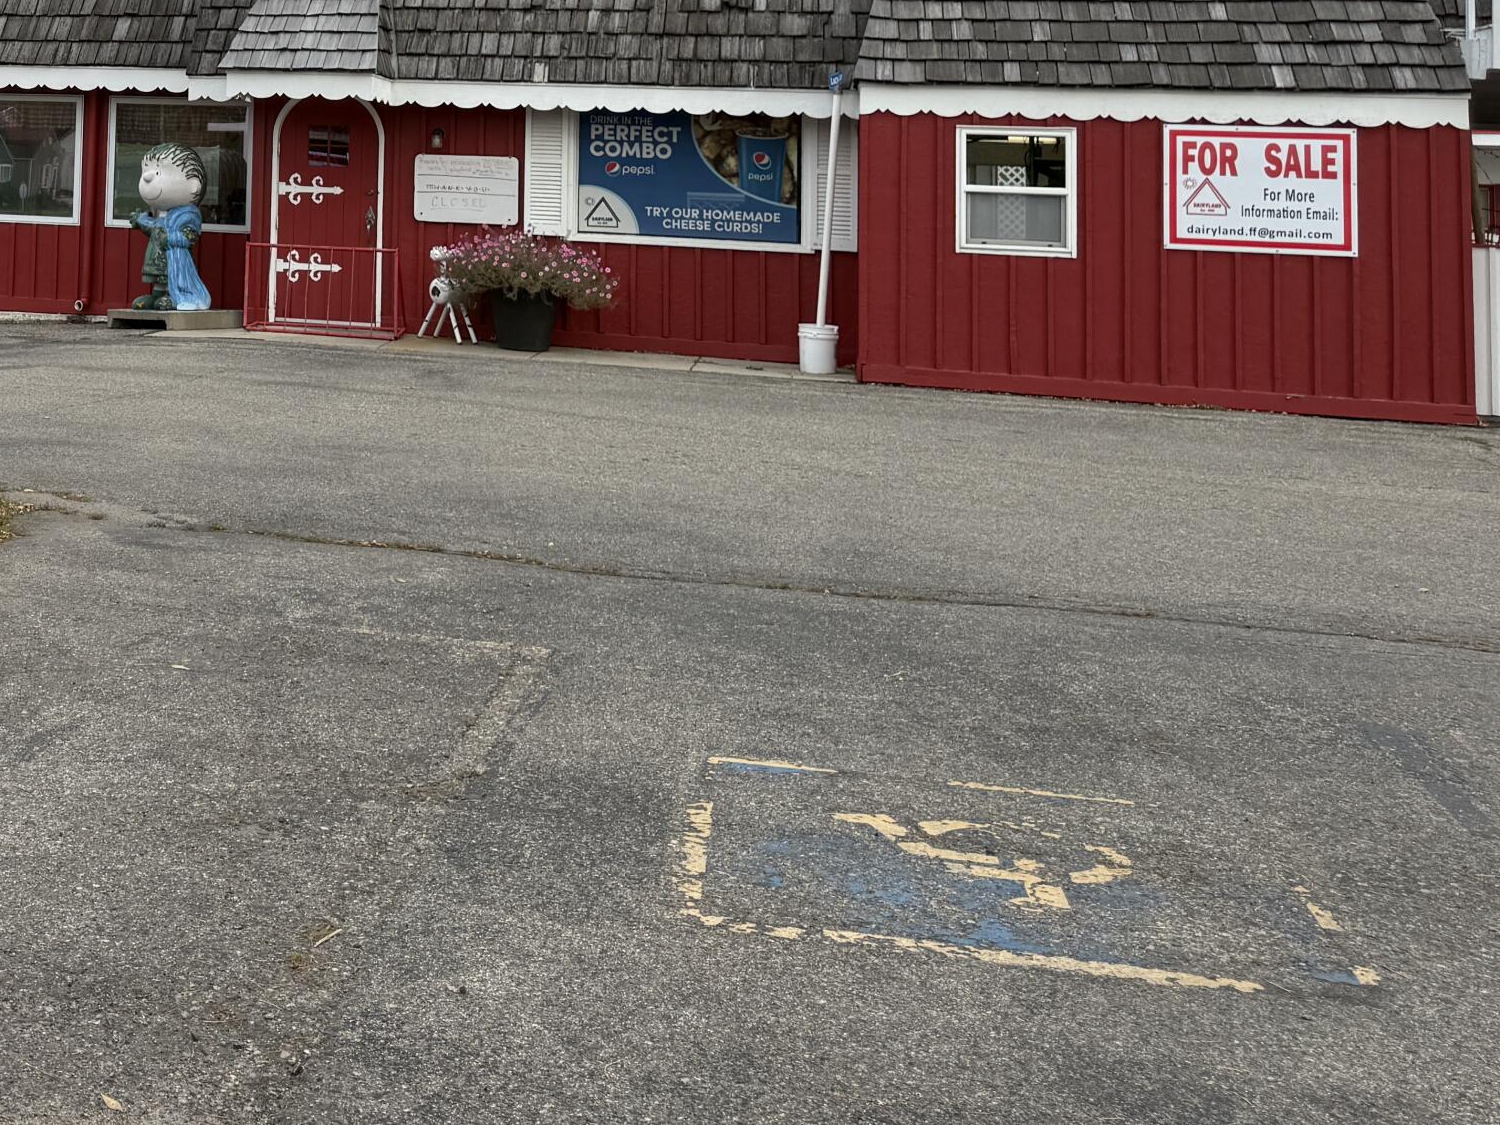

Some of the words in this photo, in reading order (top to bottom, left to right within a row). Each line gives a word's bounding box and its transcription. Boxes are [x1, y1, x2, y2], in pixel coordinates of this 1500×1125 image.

[590, 115, 620, 124] DRINK
[621, 116, 631, 125] IN
[635, 116, 653, 126] THE
[590, 124, 682, 143] PERFECT
[589, 140, 672, 159] COMBO
[1182, 141, 1238, 176] FOR
[1264, 143, 1338, 180] SALE
[622, 164, 655, 176] pepsi
[1263, 188, 1282, 202] For
[1285, 188, 1315, 203] More
[644, 206, 670, 217] TRY
[671, 207, 700, 219] OUR
[703, 209, 781, 223] HOMEMADE
[1241, 204, 1302, 219] Information
[1306, 207, 1339, 221] Email:
[662, 219, 711, 231] CHEESE
[714, 221, 763, 234] CURDS!
[1187, 224, 1333, 239] dairyland.ff@gmail.com
